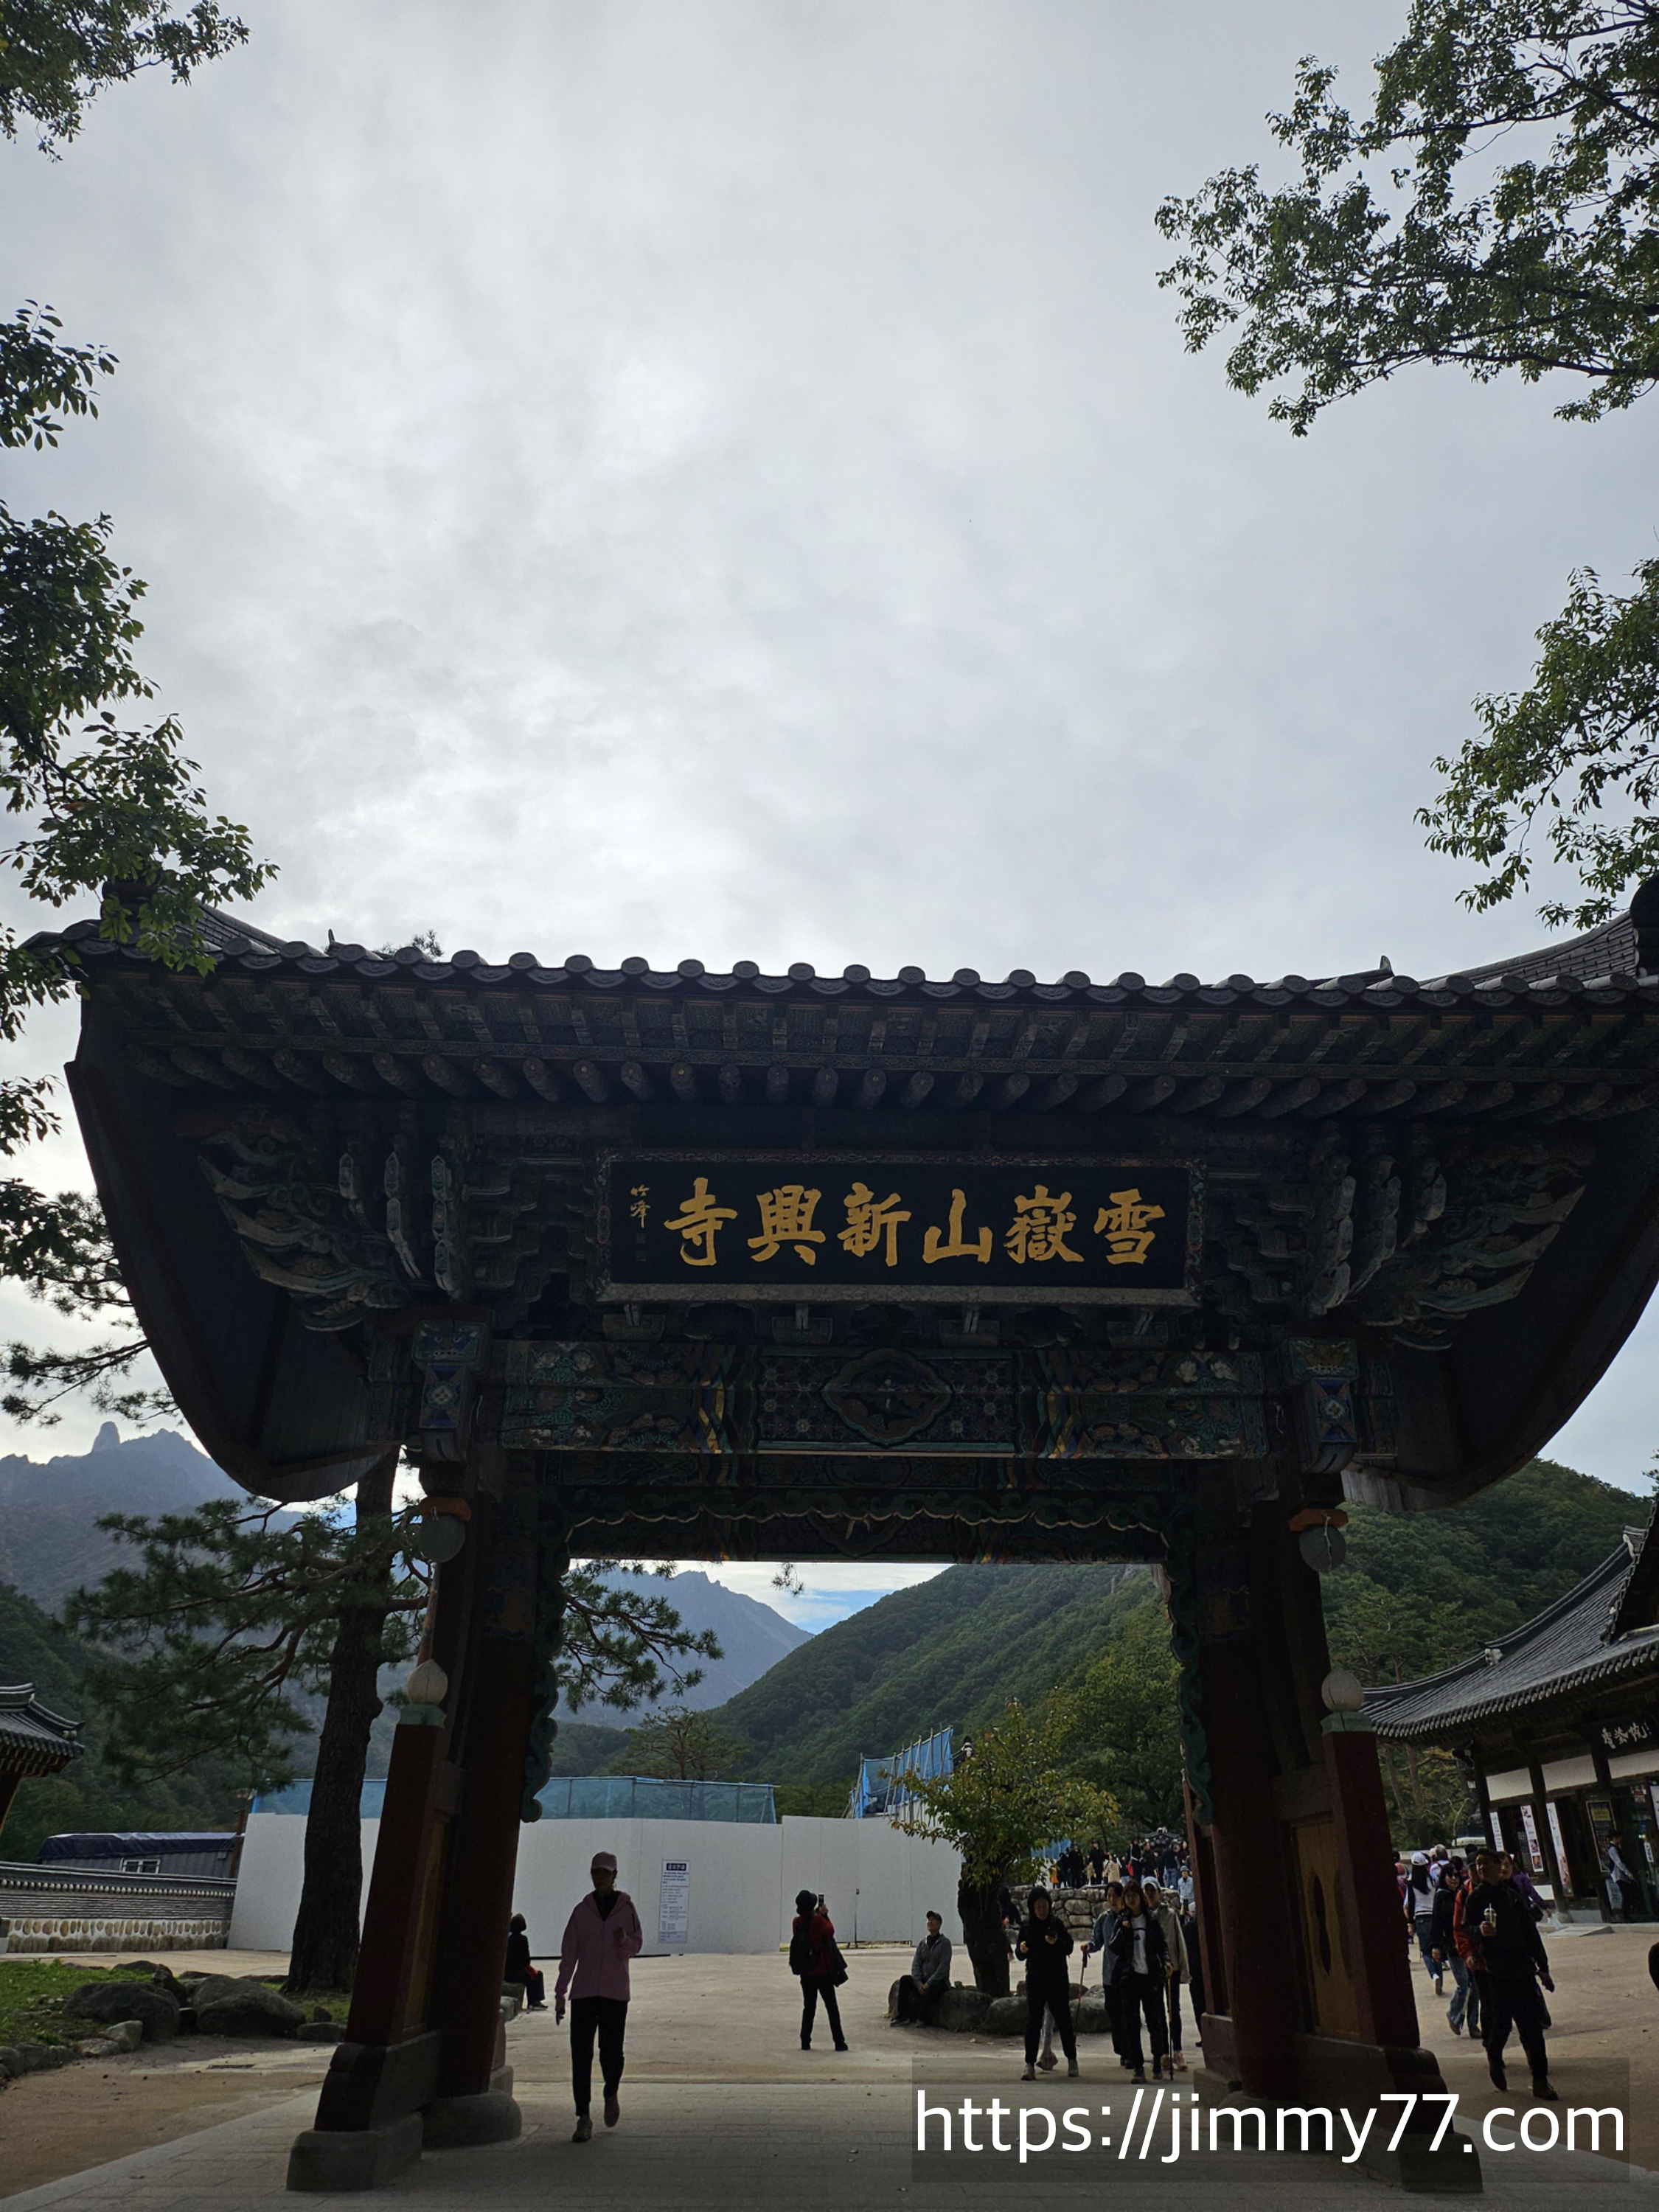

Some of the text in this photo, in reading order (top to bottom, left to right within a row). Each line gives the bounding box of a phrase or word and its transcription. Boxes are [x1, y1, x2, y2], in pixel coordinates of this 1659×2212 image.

[664, 1177, 1165, 1266] 雪嶽山新興寺
